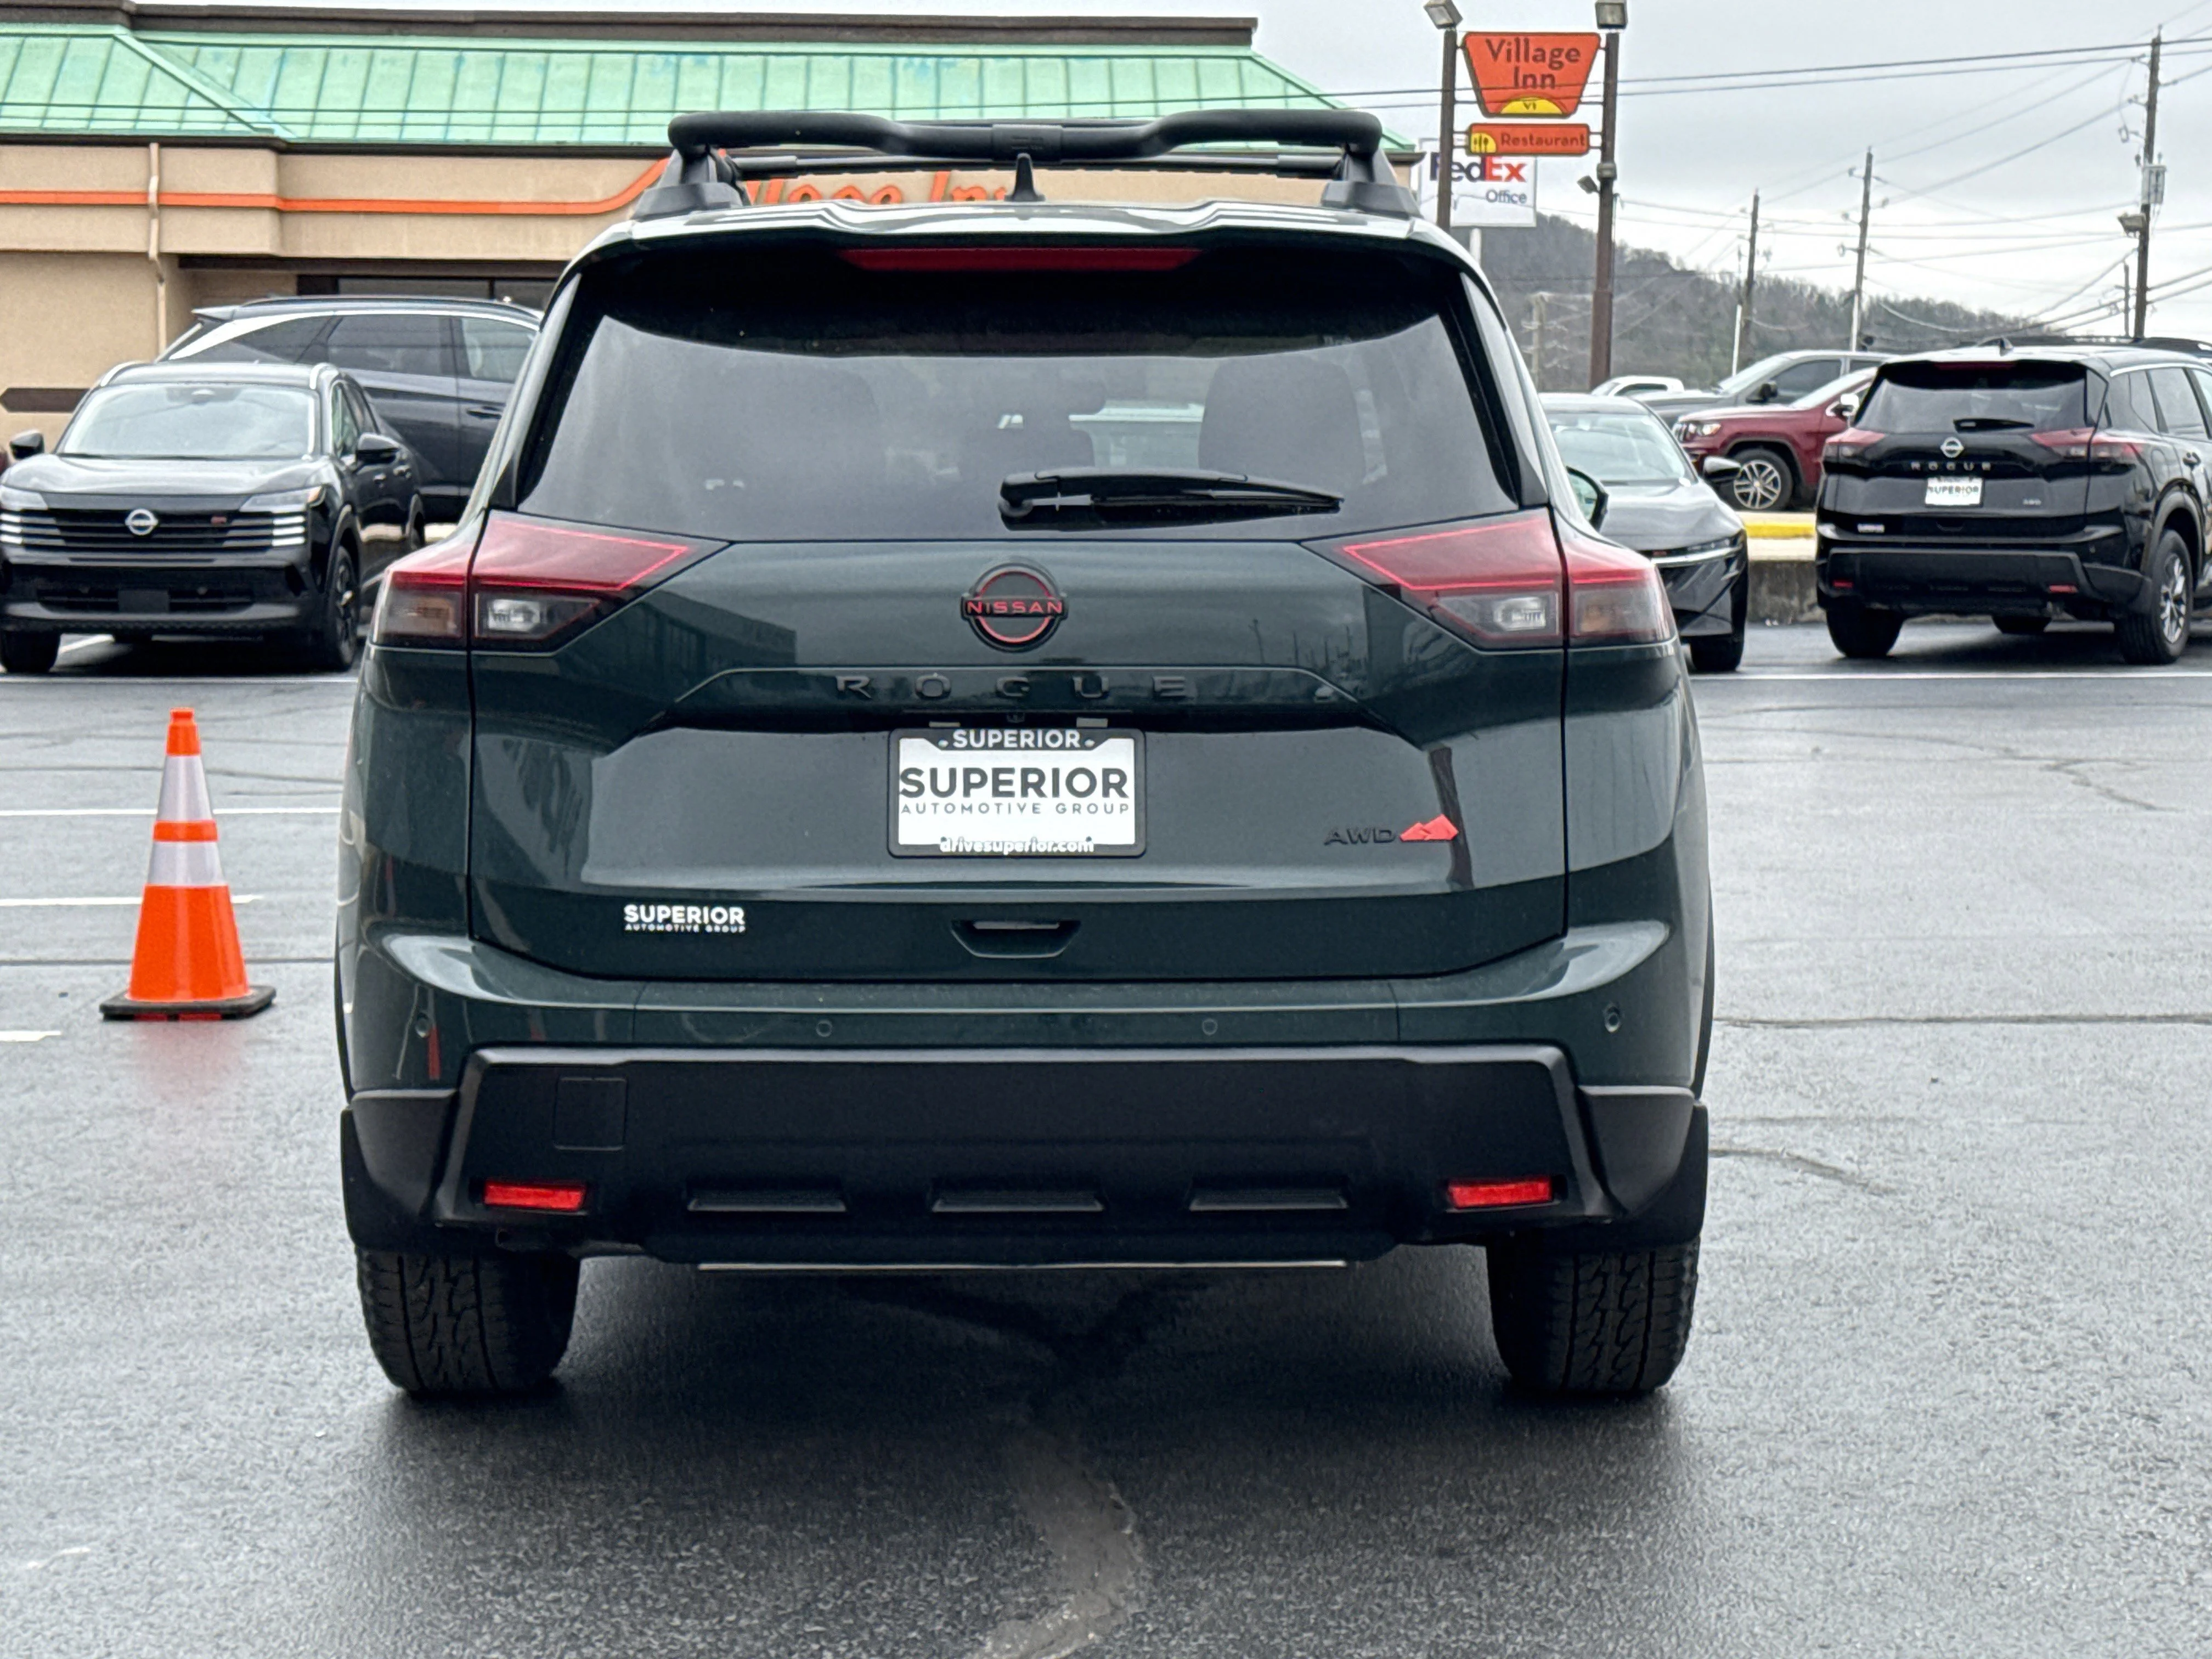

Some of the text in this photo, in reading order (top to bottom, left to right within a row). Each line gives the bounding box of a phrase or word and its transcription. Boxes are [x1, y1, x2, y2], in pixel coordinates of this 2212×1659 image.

[1485, 37, 1581, 71] Village
[1513, 66, 1556, 89] Inn
[1500, 132, 1585, 146] Restaurant
[1486, 189, 1527, 204] Office
[966, 601, 1063, 614] NISSAN
[836, 675, 1187, 699] ROGUE
[952, 729, 1081, 748] SUPERIOR
[899, 767, 1129, 798] SUPERIOR
[900, 802, 1129, 815] AUTOMOTIVE GROUP
[1323, 826, 1397, 845] AWD
[939, 836, 1094, 855] drivesuperior.com
[624, 905, 746, 924] SUPERIOR
